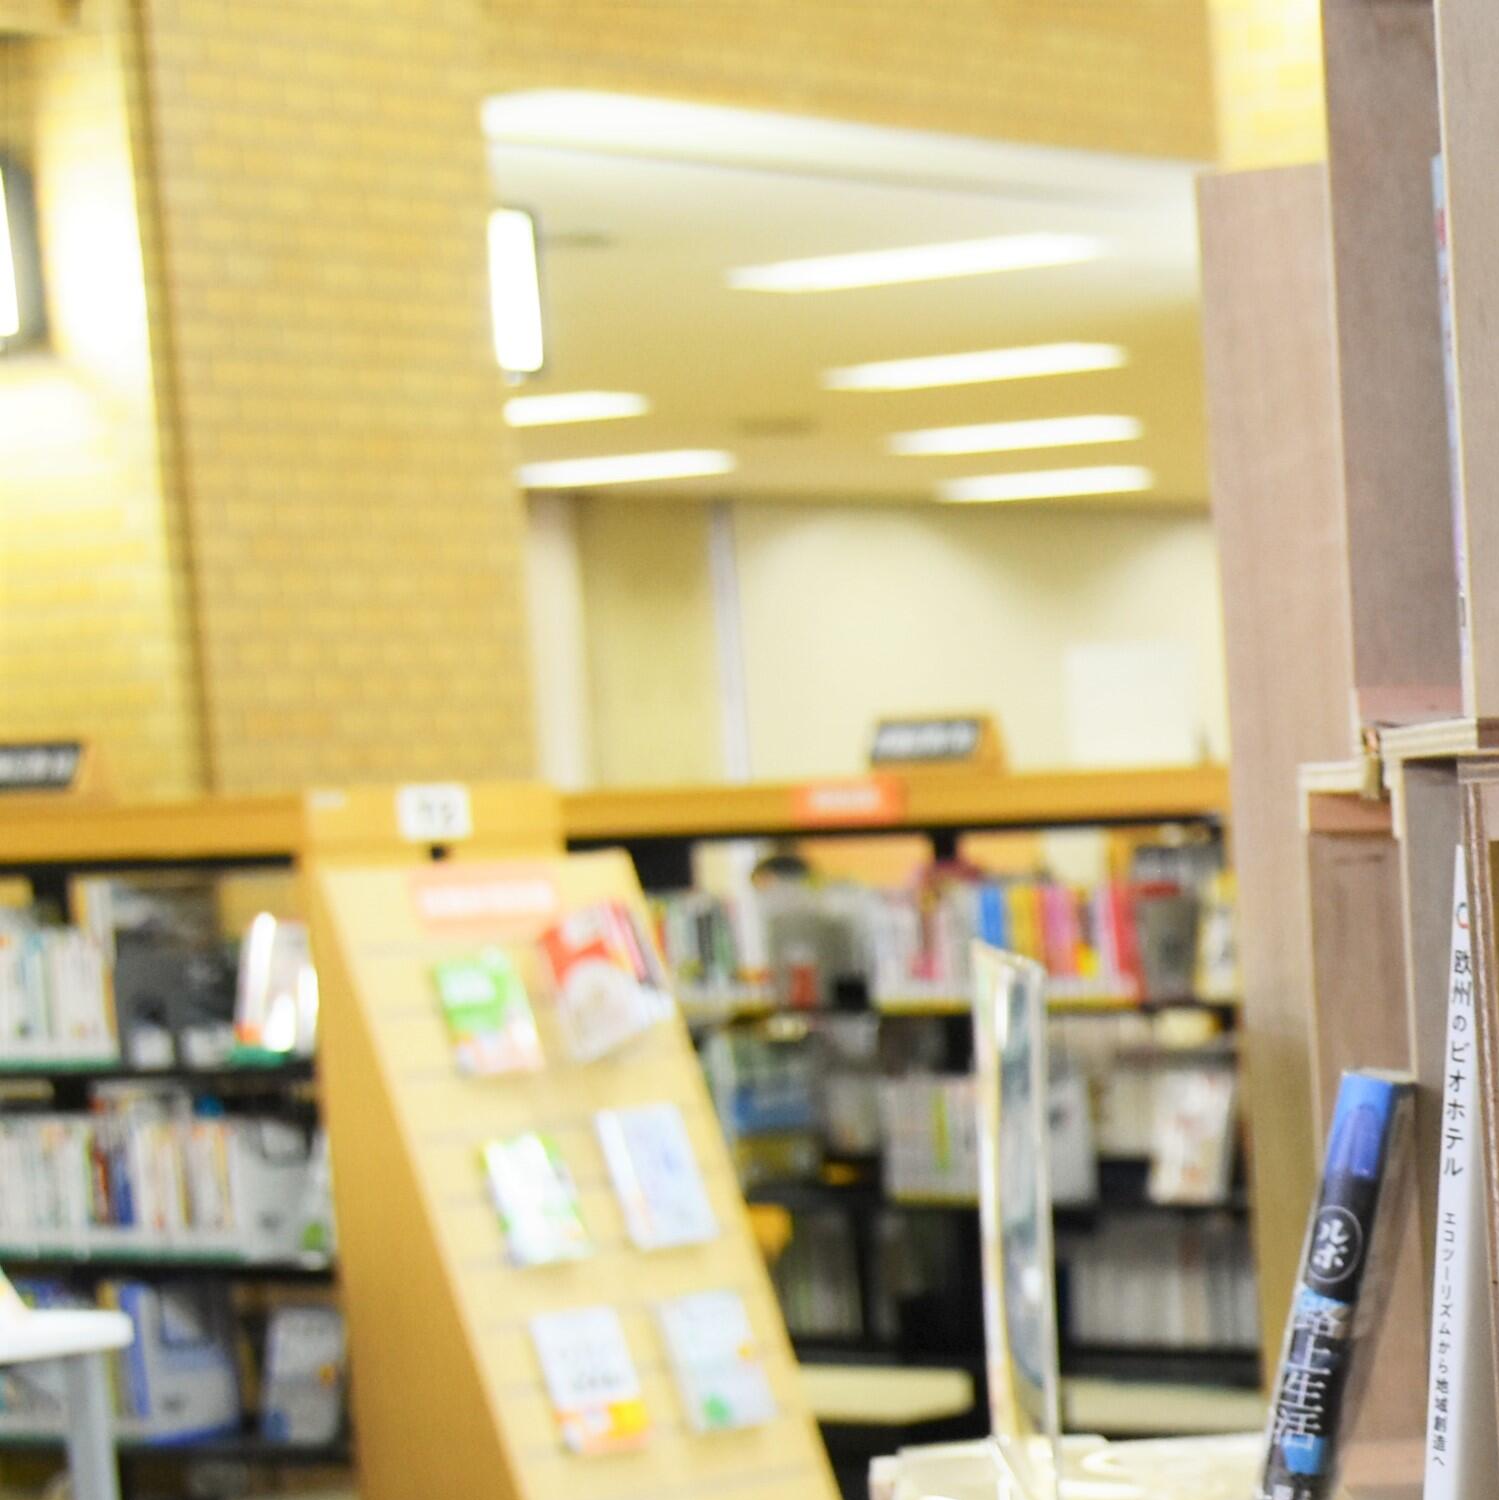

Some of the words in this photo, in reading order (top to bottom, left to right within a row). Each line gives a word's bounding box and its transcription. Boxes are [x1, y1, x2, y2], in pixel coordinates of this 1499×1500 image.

[1441, 949, 1474, 1178] 欧州のビオホテル
[1313, 1215, 1351, 1273] ルポ
